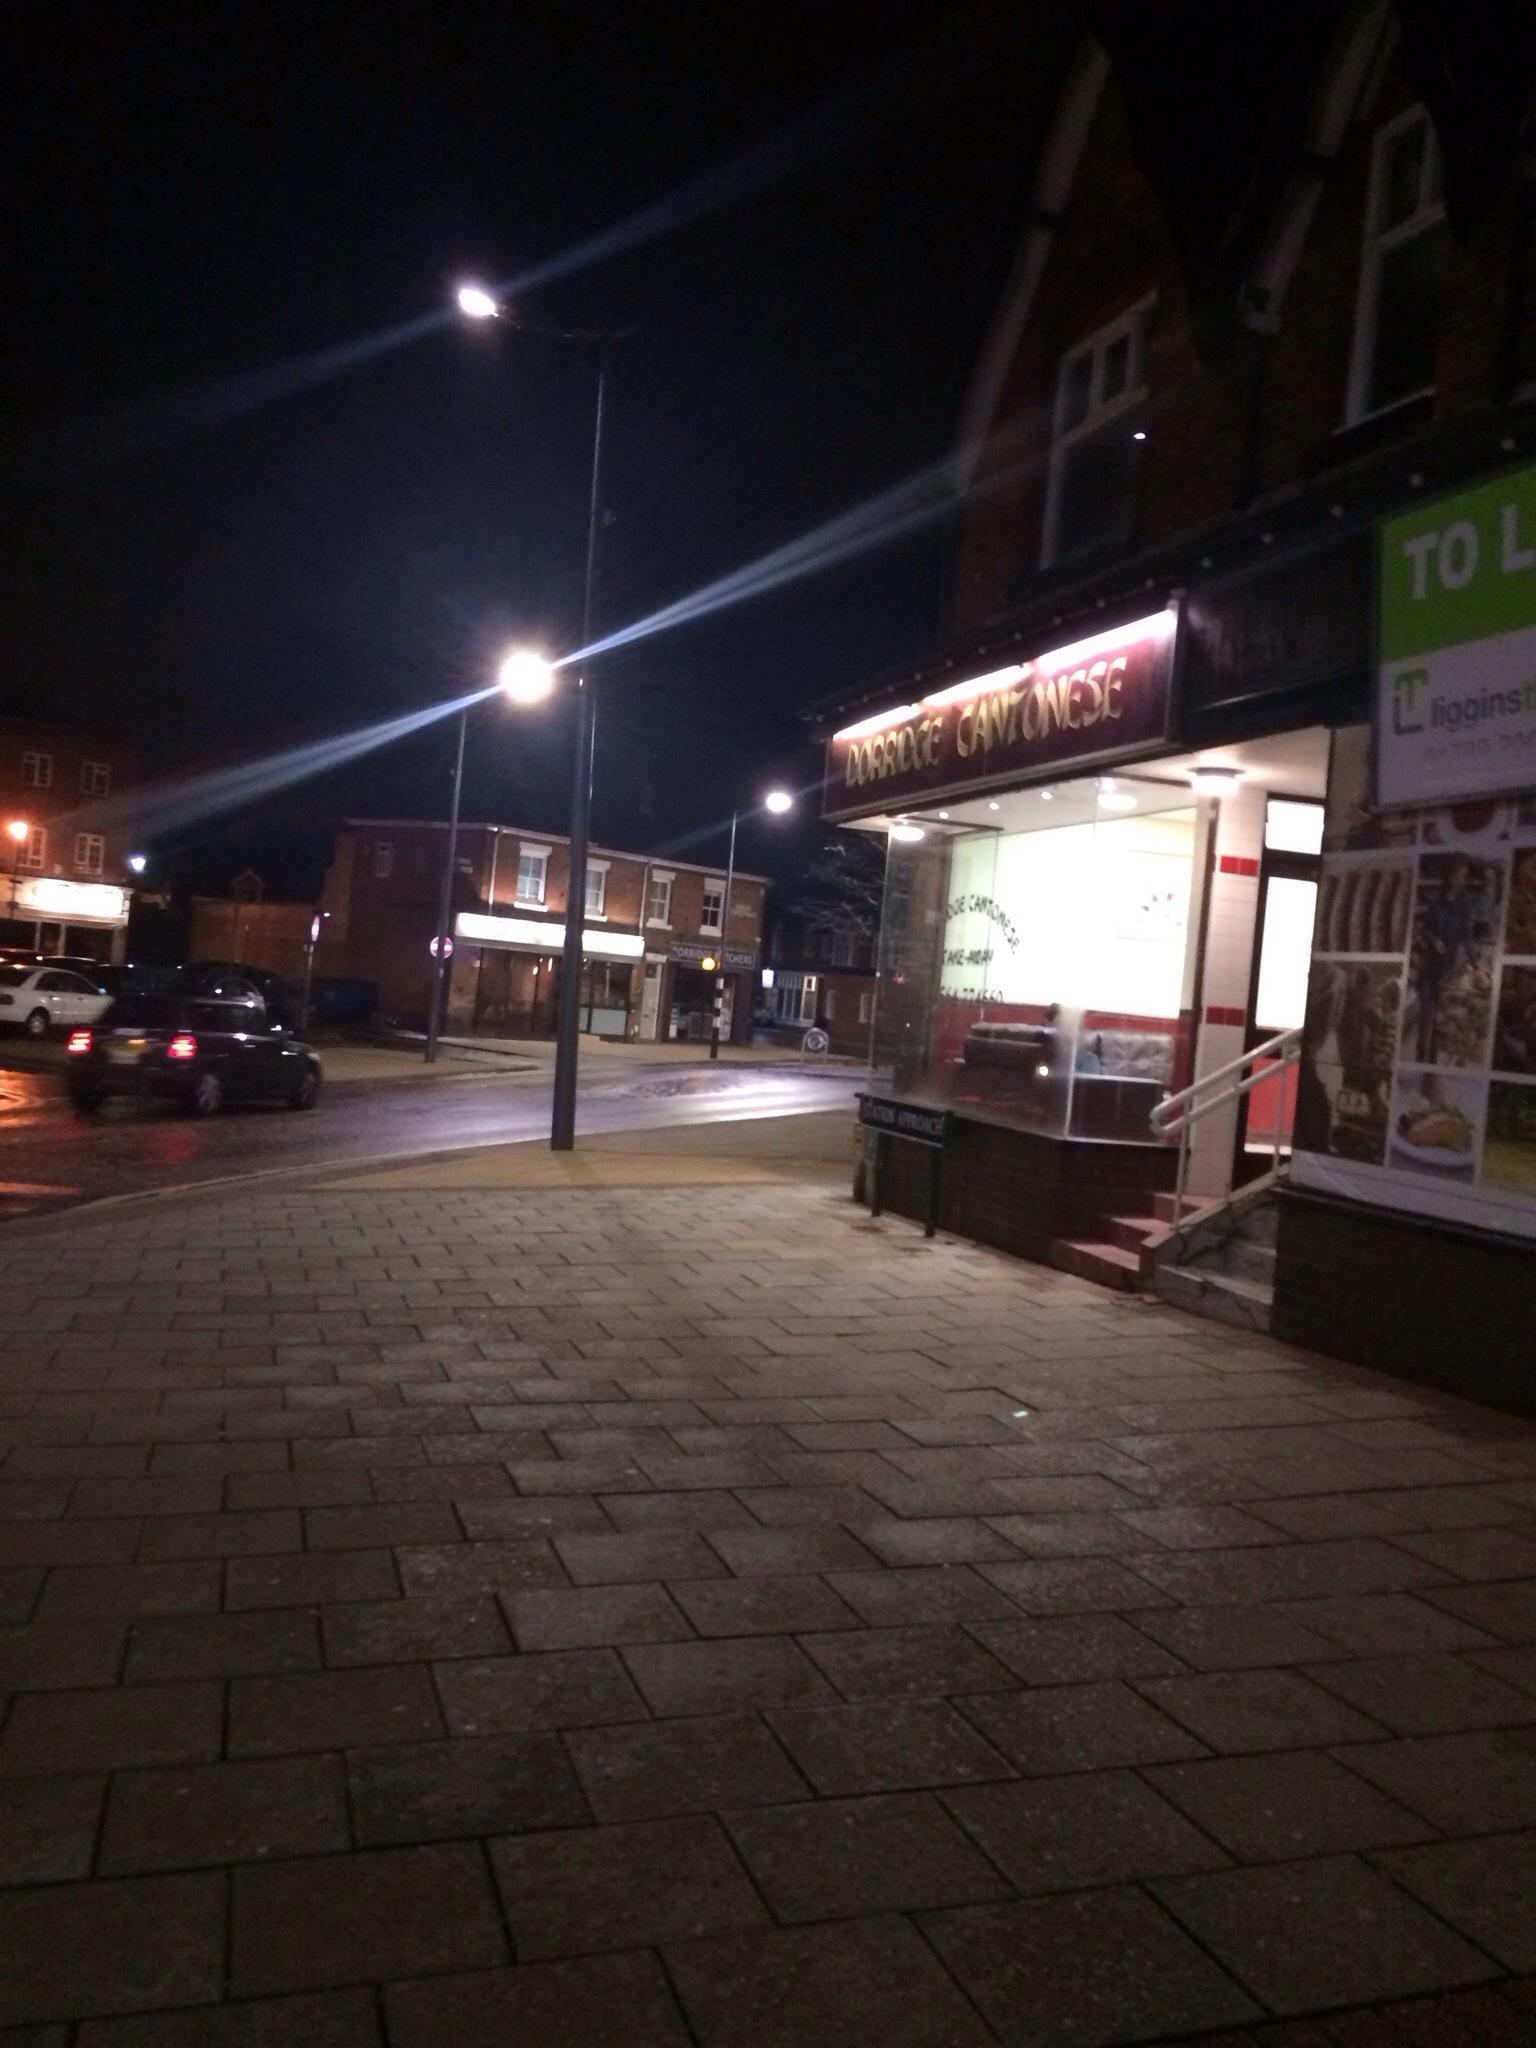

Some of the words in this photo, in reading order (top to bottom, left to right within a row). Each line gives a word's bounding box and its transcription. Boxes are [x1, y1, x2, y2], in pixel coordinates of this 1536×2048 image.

[1402, 520, 1480, 601] TO
[846, 716, 943, 788] DORRIDGE
[955, 656, 1128, 759] CANTONESE
